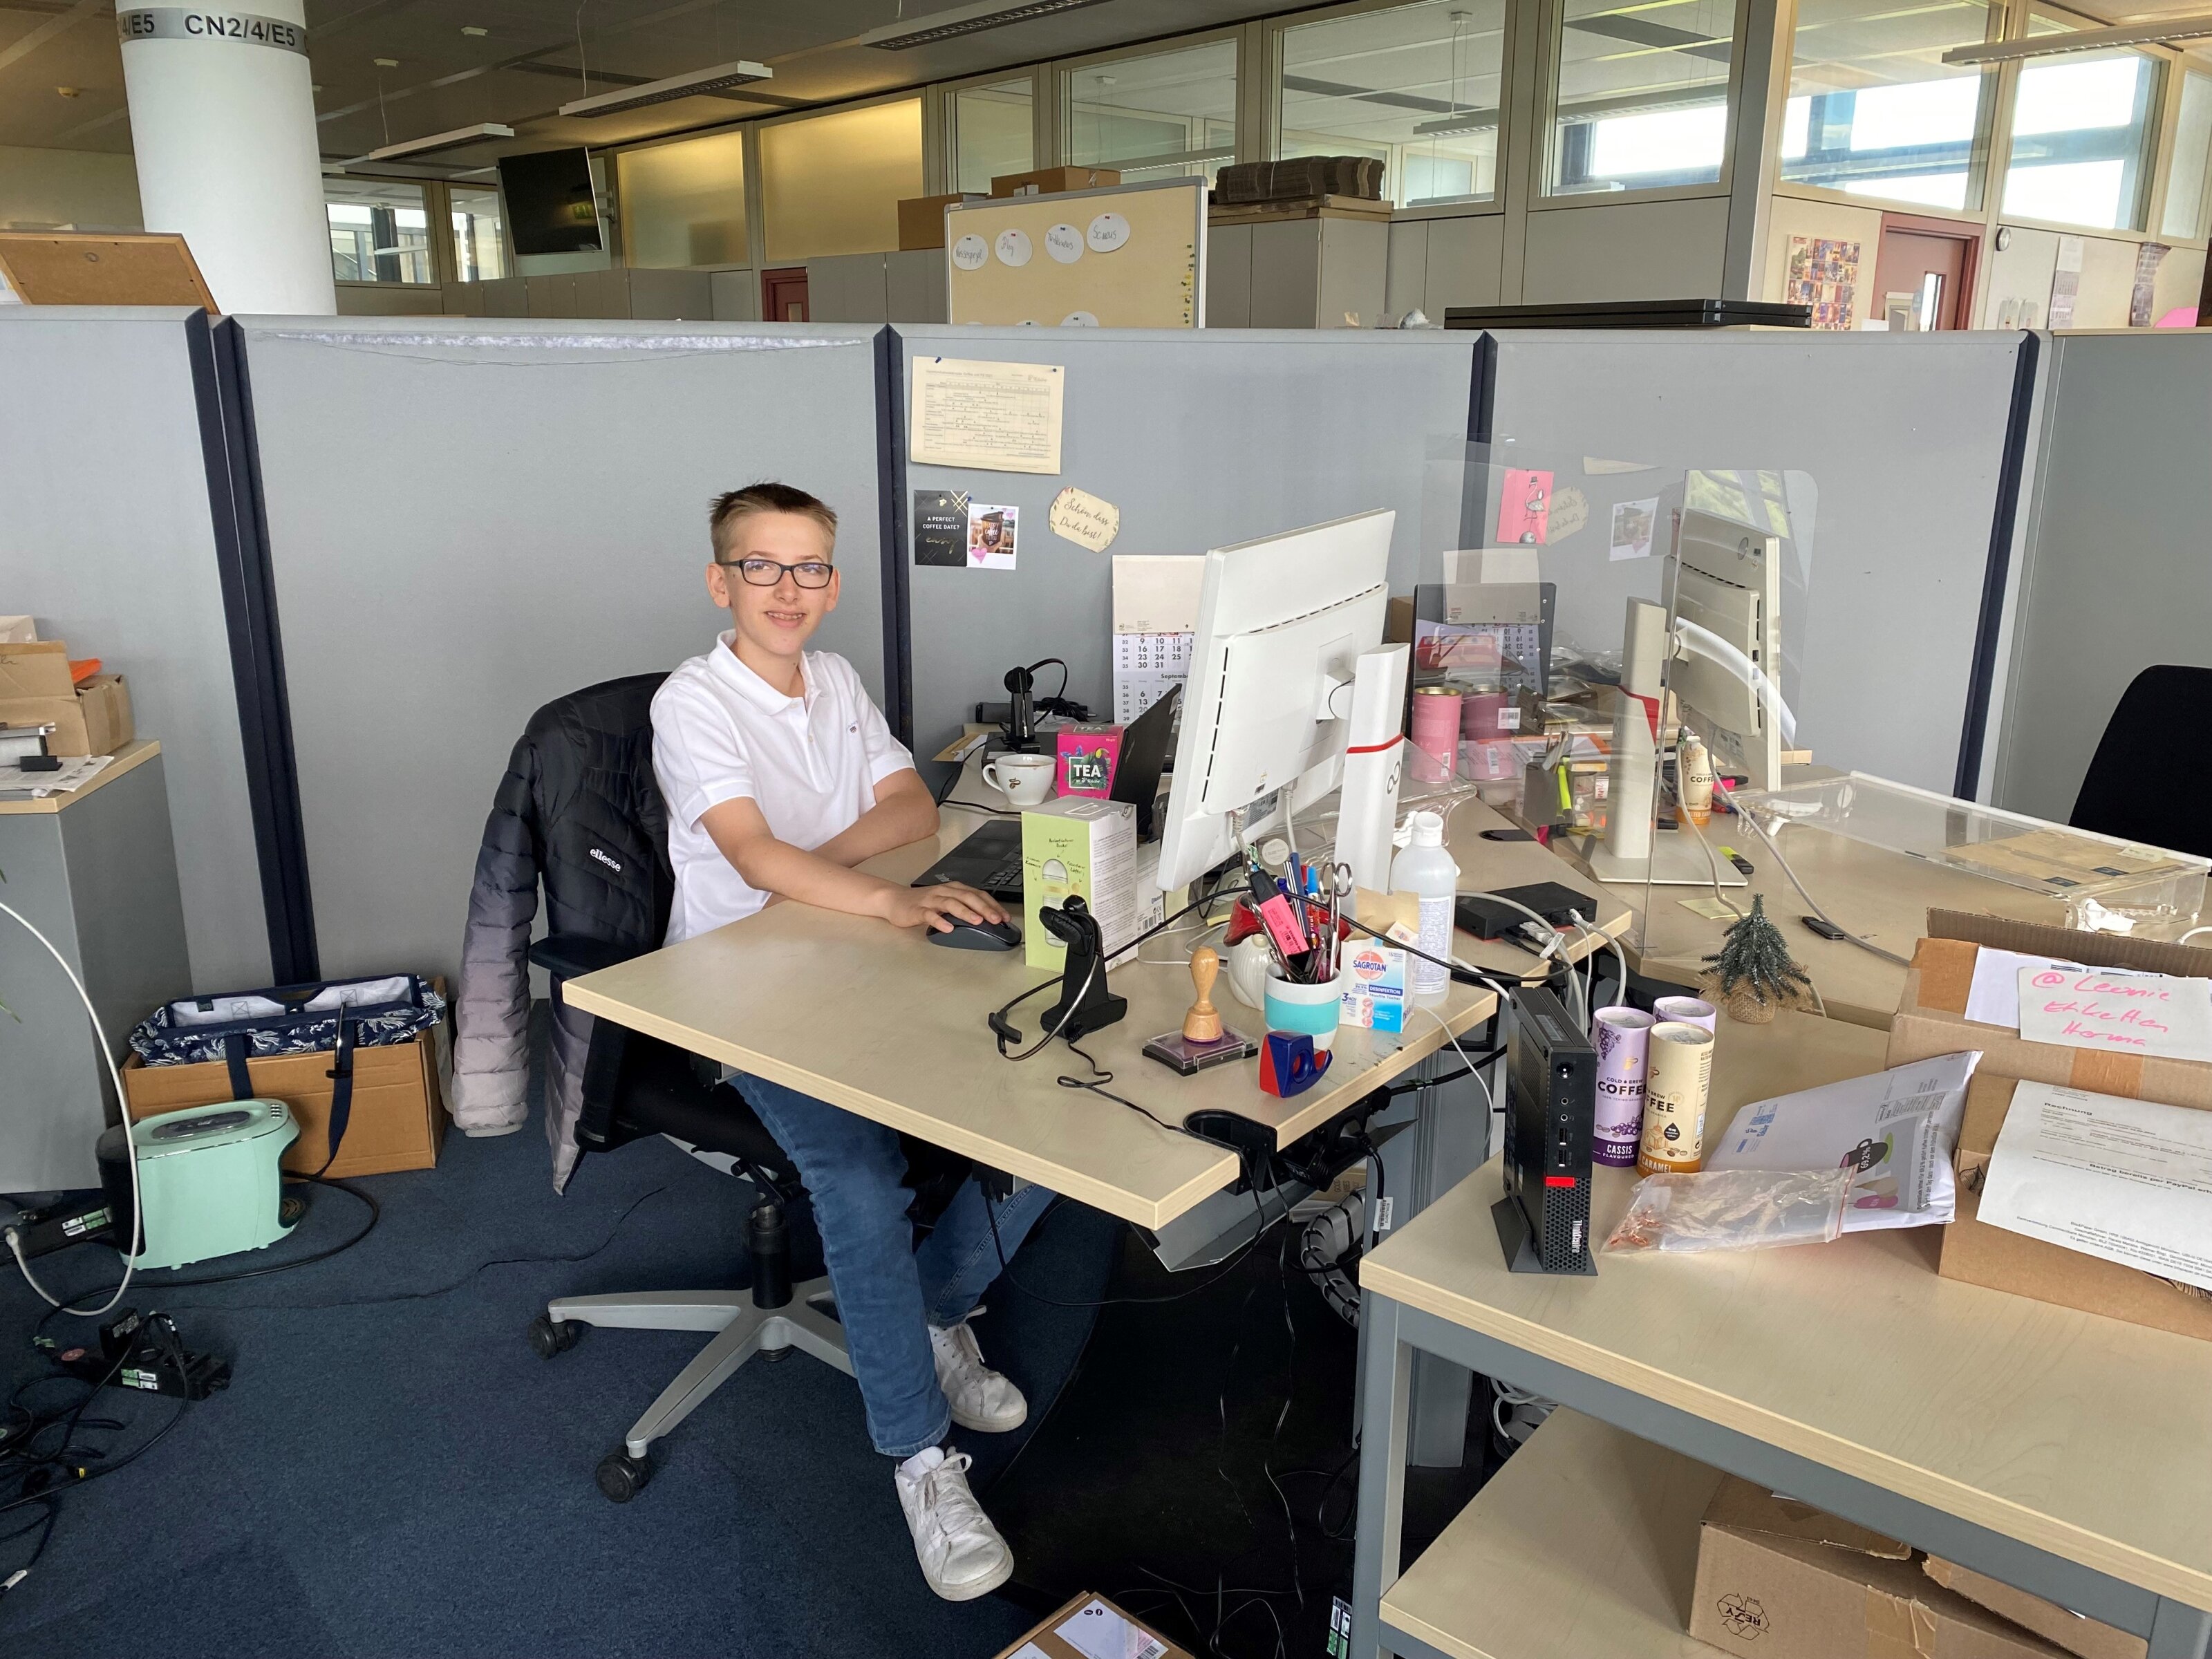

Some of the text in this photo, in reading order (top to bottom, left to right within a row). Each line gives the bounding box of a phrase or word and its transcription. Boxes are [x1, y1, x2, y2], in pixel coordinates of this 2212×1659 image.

[185, 14, 296, 46] CN2/4/E5
[1064, 498, 1109, 525] Schön, dass
[1060, 516, 1102, 539] Du da bist!
[1073, 765, 1101, 777] TEA
[590, 849, 621, 872] ellesse
[1353, 959, 1387, 973] SAGROTAN
[1342, 993, 1348, 1002] 3
[1369, 986, 1401, 995] DESINFEKTION
[2032, 971, 2171, 1002] @ Leonie
[2043, 1001, 2168, 1033] Etiketten
[1651, 1091, 1666, 1100] BREW
[2044, 1102, 2093, 1116] Rechnung
[1606, 1144, 1633, 1155] CASSIS
[1860, 1145, 1872, 1169] 69,2%
[2090, 1163, 2117, 1173] Betrag
[2119, 1170, 2148, 1180] bereits
[2166, 1181, 2195, 1191] PayPal
